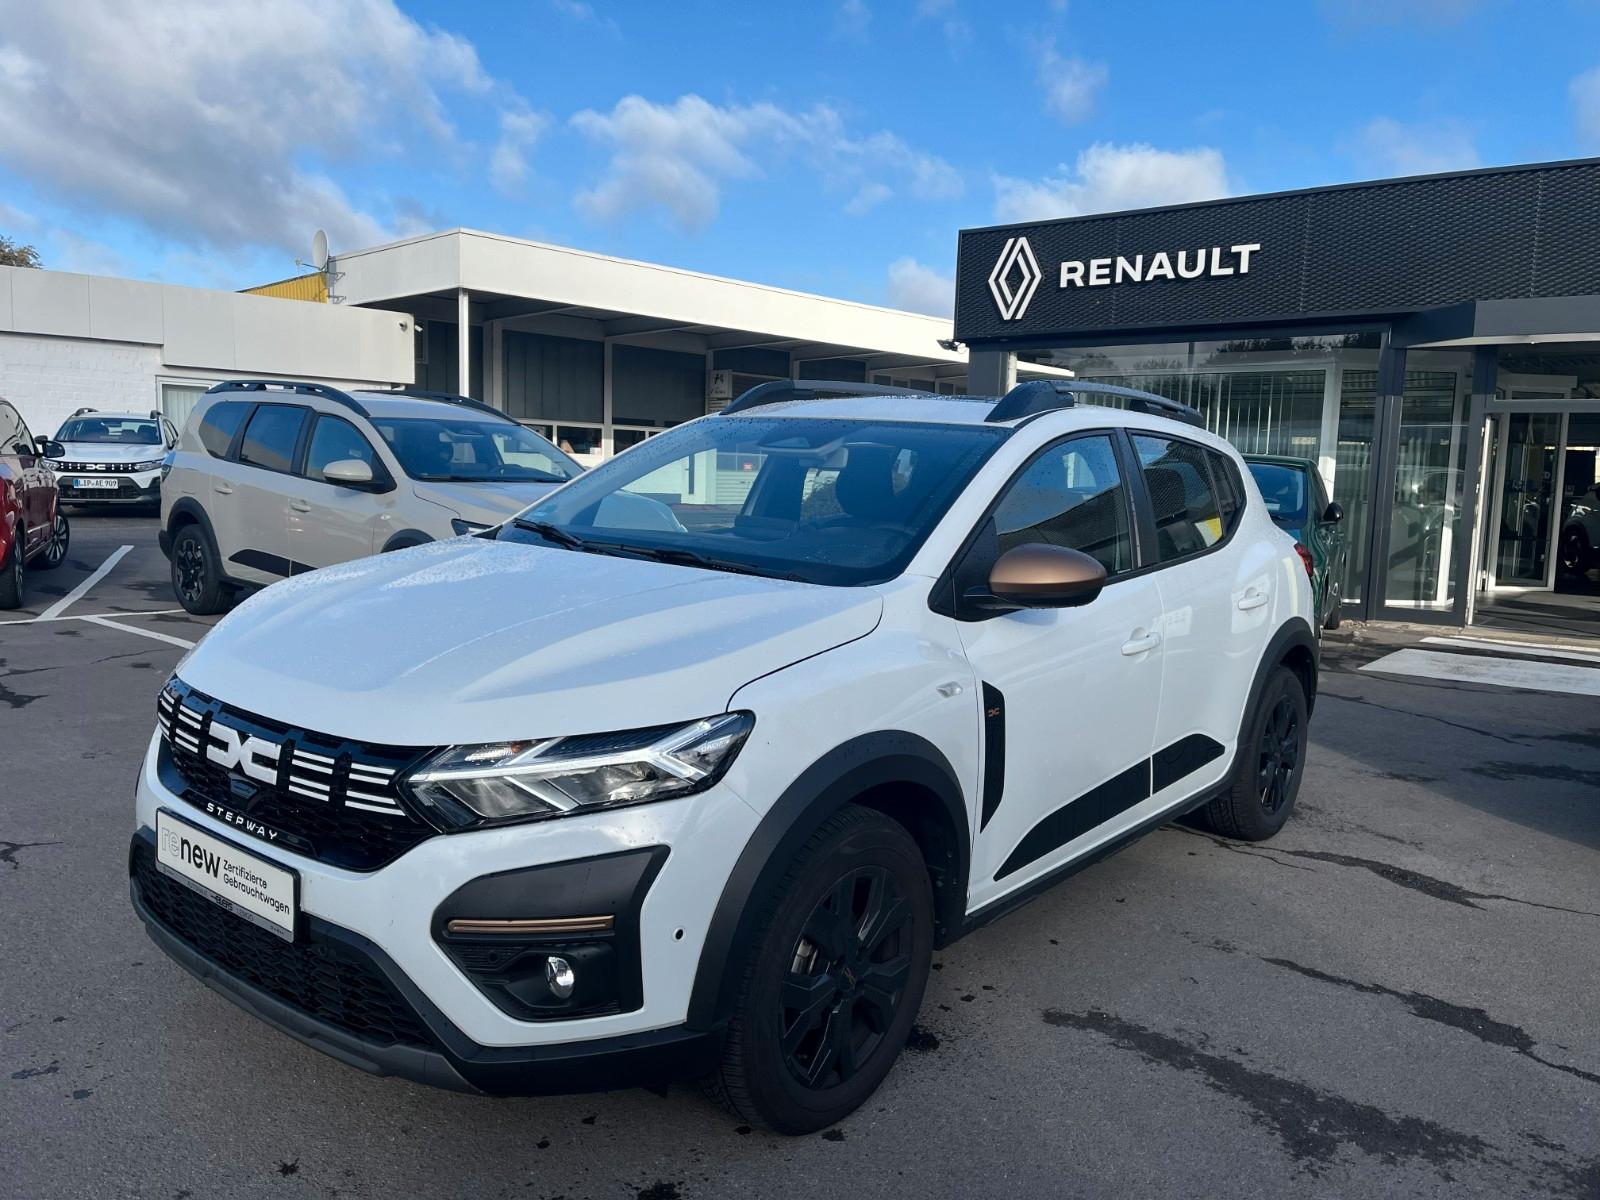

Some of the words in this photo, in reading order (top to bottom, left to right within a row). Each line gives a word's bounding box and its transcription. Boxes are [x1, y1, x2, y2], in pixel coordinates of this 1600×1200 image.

[1059, 243, 1261, 288] RENAULT
[206, 802, 278, 840] STEPWAY
[223, 859, 268, 889] Zertifizierte
[223, 873, 290, 915] Gebrauchtwagen
